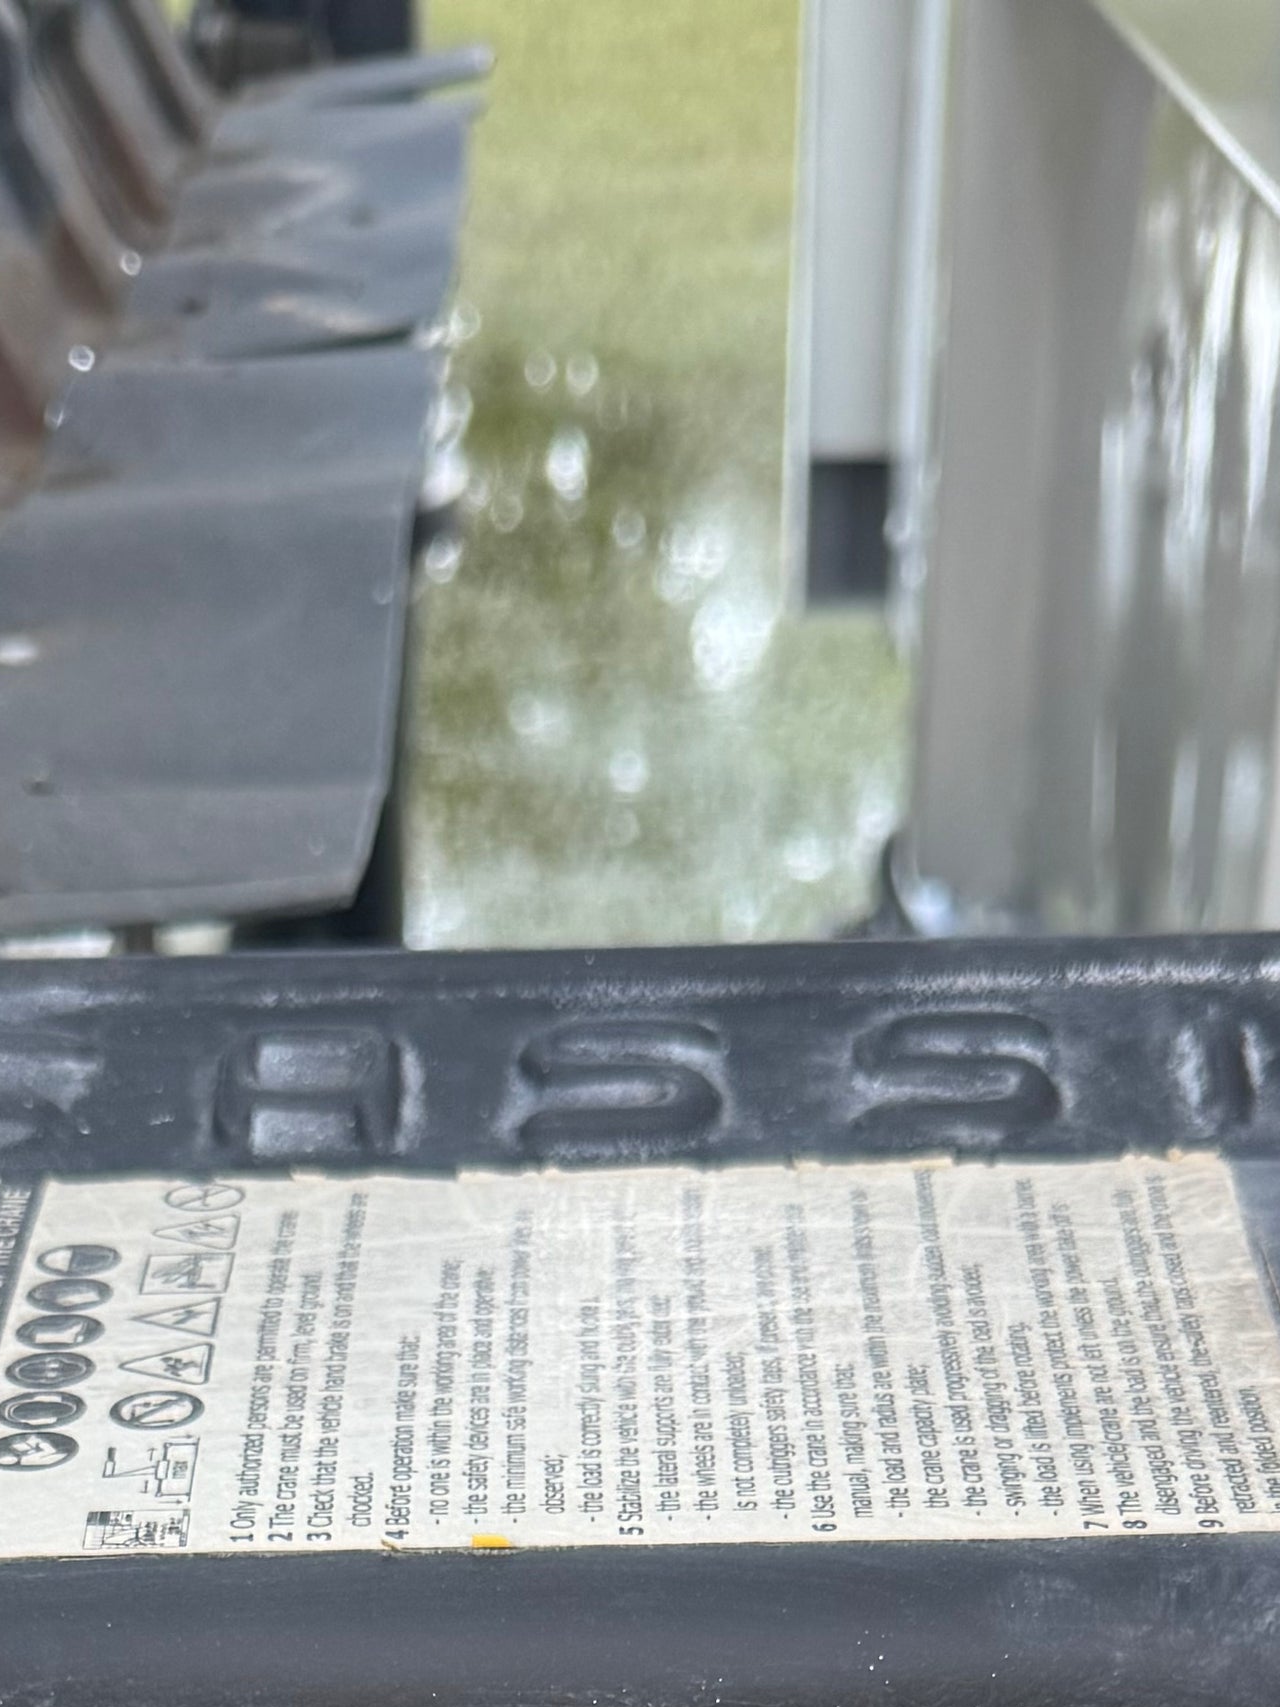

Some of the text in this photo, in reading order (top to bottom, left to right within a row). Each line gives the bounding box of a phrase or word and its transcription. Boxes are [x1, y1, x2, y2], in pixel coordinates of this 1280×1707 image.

[229, 1364, 273, 1541] 1 Only authorized persons are
[268, 1367, 308, 1541] 2 The crane must be used on
[307, 1332, 348, 1540] 3 Check that the vehicle hand brake
[384, 1363, 417, 1539] 4 Before operation make sure
[428, 1351, 456, 1515] no one is within the working
[463, 1385, 492, 1514] the safety devices are
[502, 1406, 526, 1513] the minimum safe
[653, 1396, 680, 1511] the lateral supports
[691, 1422, 718, 1511] the wheels are
[761, 1387, 795, 1509] the safety
[839, 1392, 872, 1517] manual, making sure
[911, 1399, 949, 1508] the crane capacity
[945, 1404, 987, 1506] the crane used
[982, 1383, 1025, 1506] swinging or dragging
[1131, 1396, 1160, 1440] and the
[1169, 1406, 1223, 1527] 9 Before the
[347, 1472, 373, 1526] chocked.
[541, 1454, 565, 1514] observed;
[578, 1449, 602, 1512] the load is
[616, 1447, 642, 1535] 5 Stabilize the
[733, 1476, 756, 1510] is not
[806, 1434, 837, 1531] 6 Use the crane
[875, 1432, 910, 1508] the load and
[1030, 1457, 1064, 1506] the load
[1069, 1443, 1108, 1529] 7 When using
[1117, 1491, 1147, 1528] 8 The
[1211, 1432, 1258, 1513] retracted and
